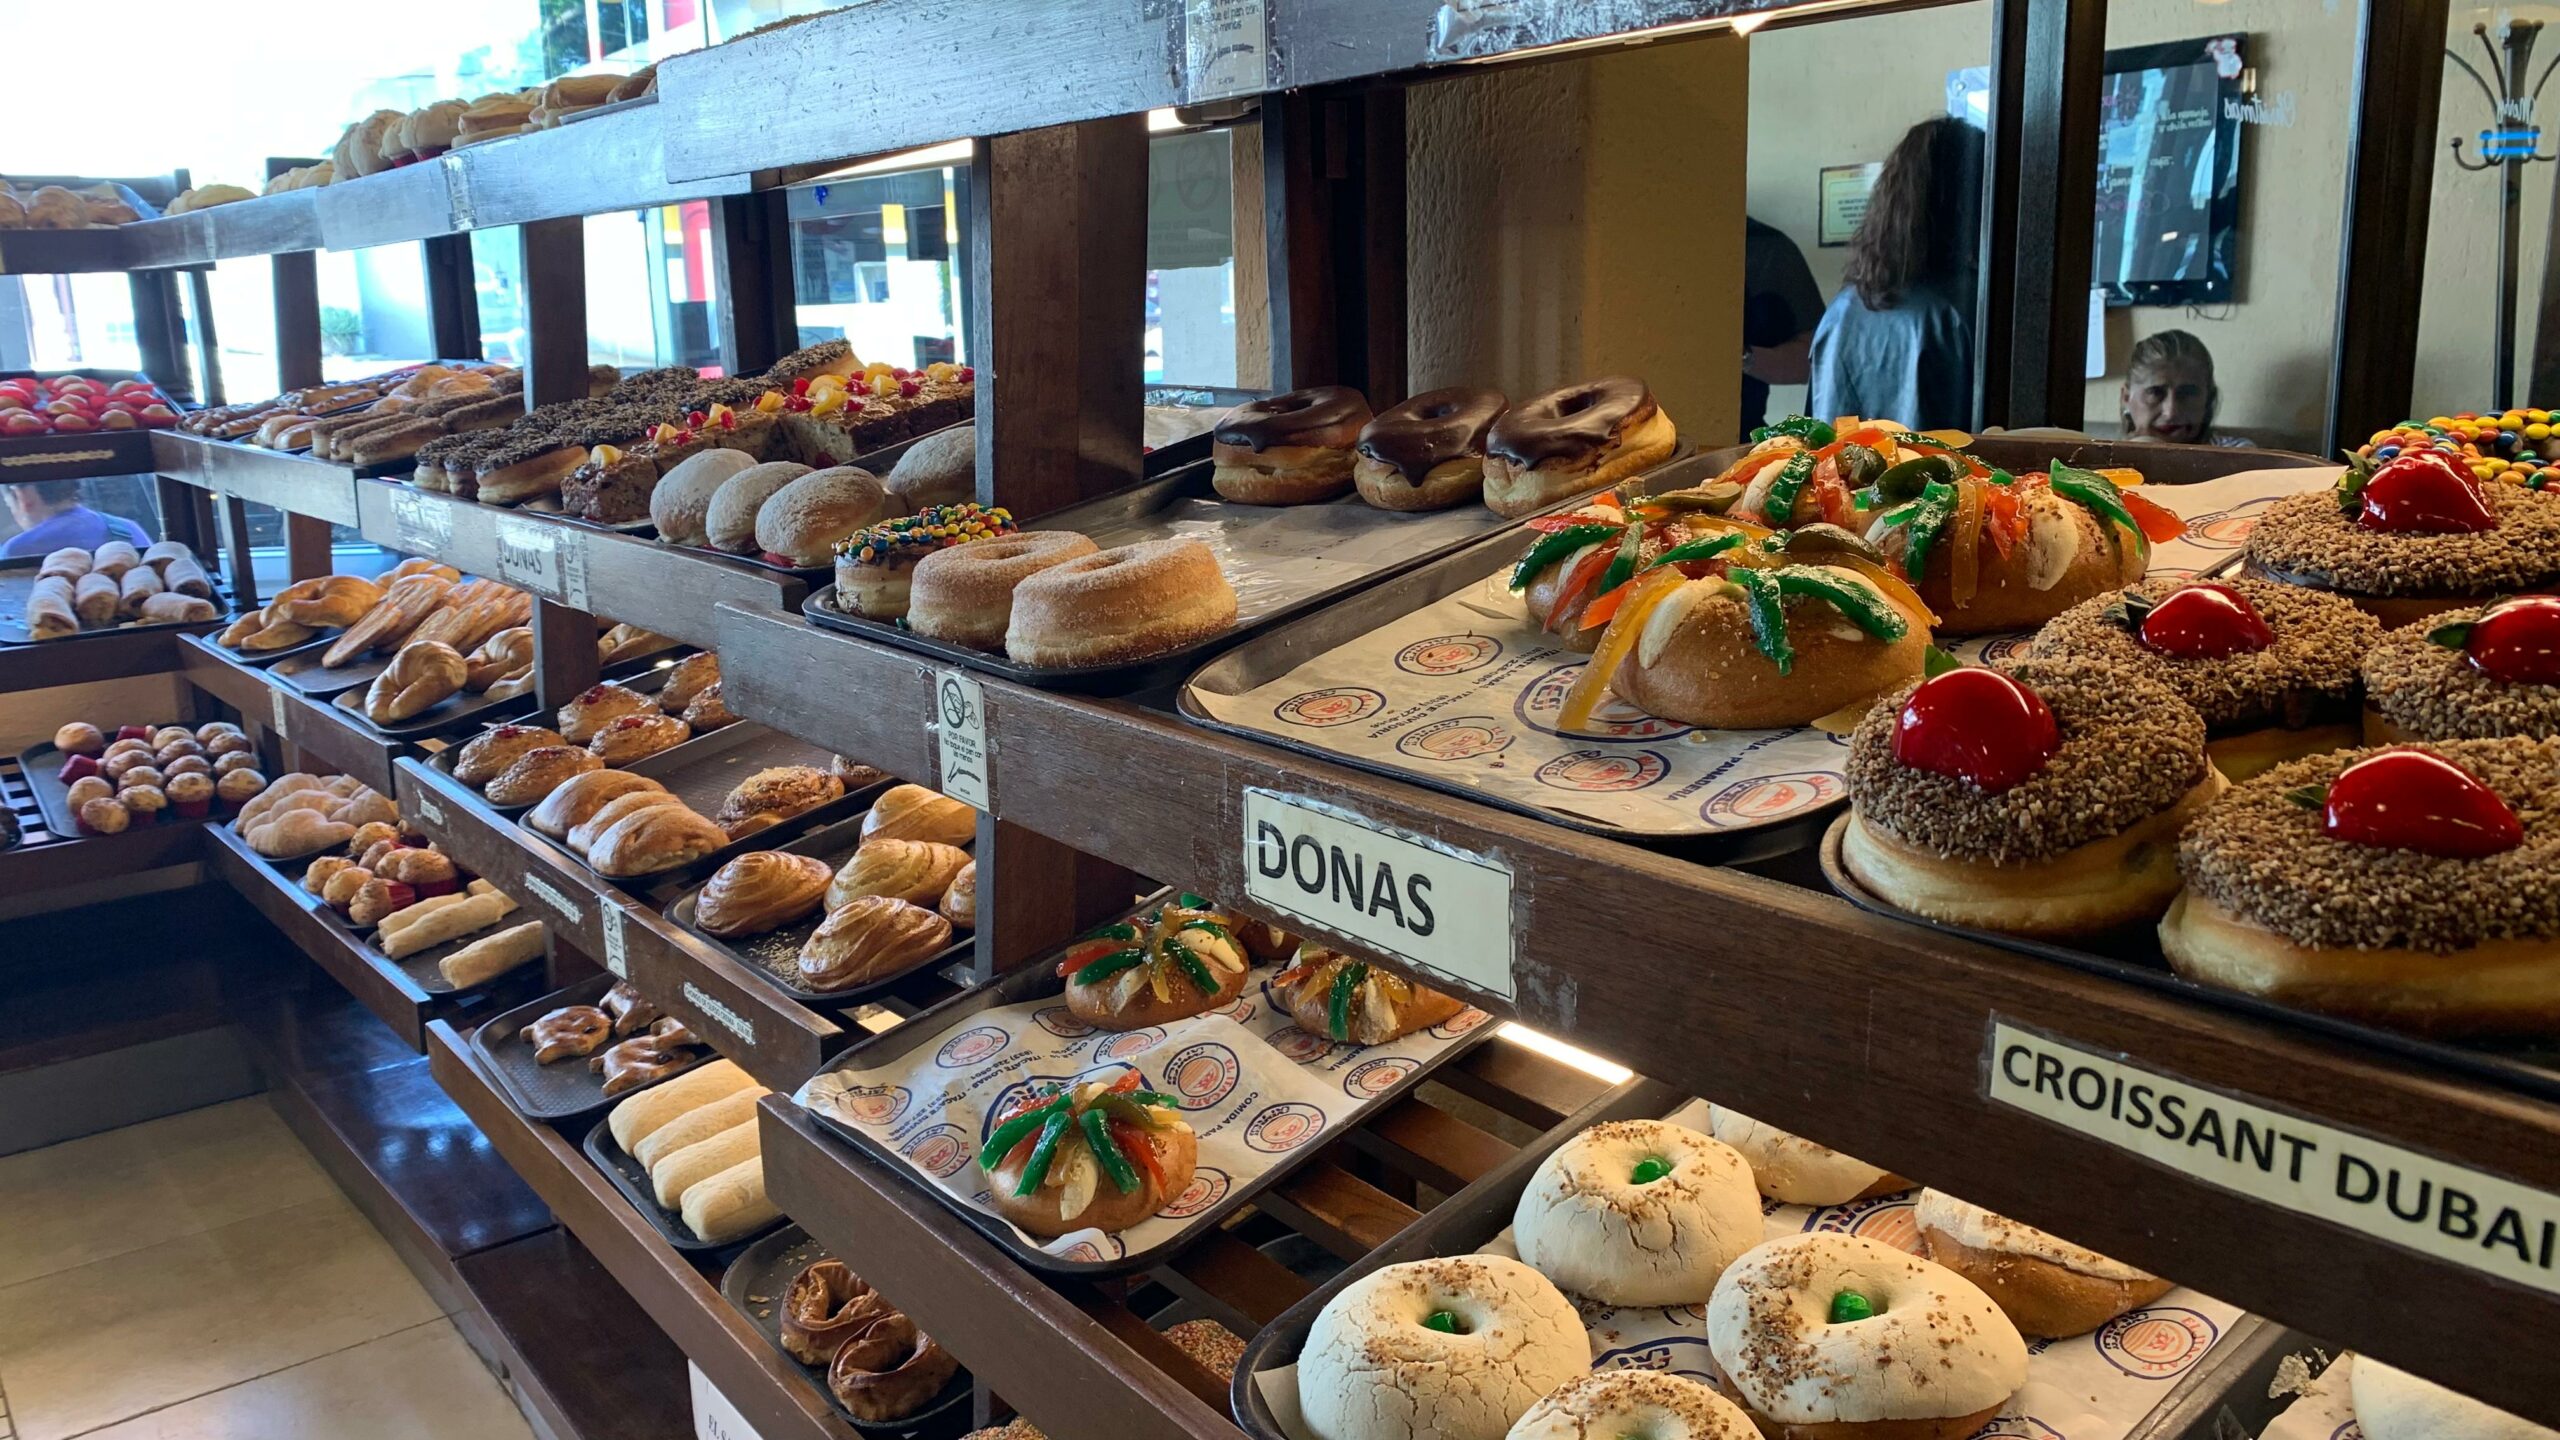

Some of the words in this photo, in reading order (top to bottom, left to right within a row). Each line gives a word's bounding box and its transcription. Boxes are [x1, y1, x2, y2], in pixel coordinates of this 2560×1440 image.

[948, 730, 958, 741] POR
[958, 733, 976, 749] FAVOR
[1368, 712, 1427, 740] DIVISORIA
[1257, 819, 1436, 937] DONAS
[1224, 1058, 1236, 1069] EL
[1187, 1071, 1236, 1107] ITACATE
[1223, 1092, 1259, 1125] COMIDA
[2001, 1044, 2317, 1183] CROISSANT
[2335, 1152, 2558, 1269] DUBAI
[2180, 1315, 2202, 1331] EL
[2141, 1334, 2207, 1371] ITACATE
